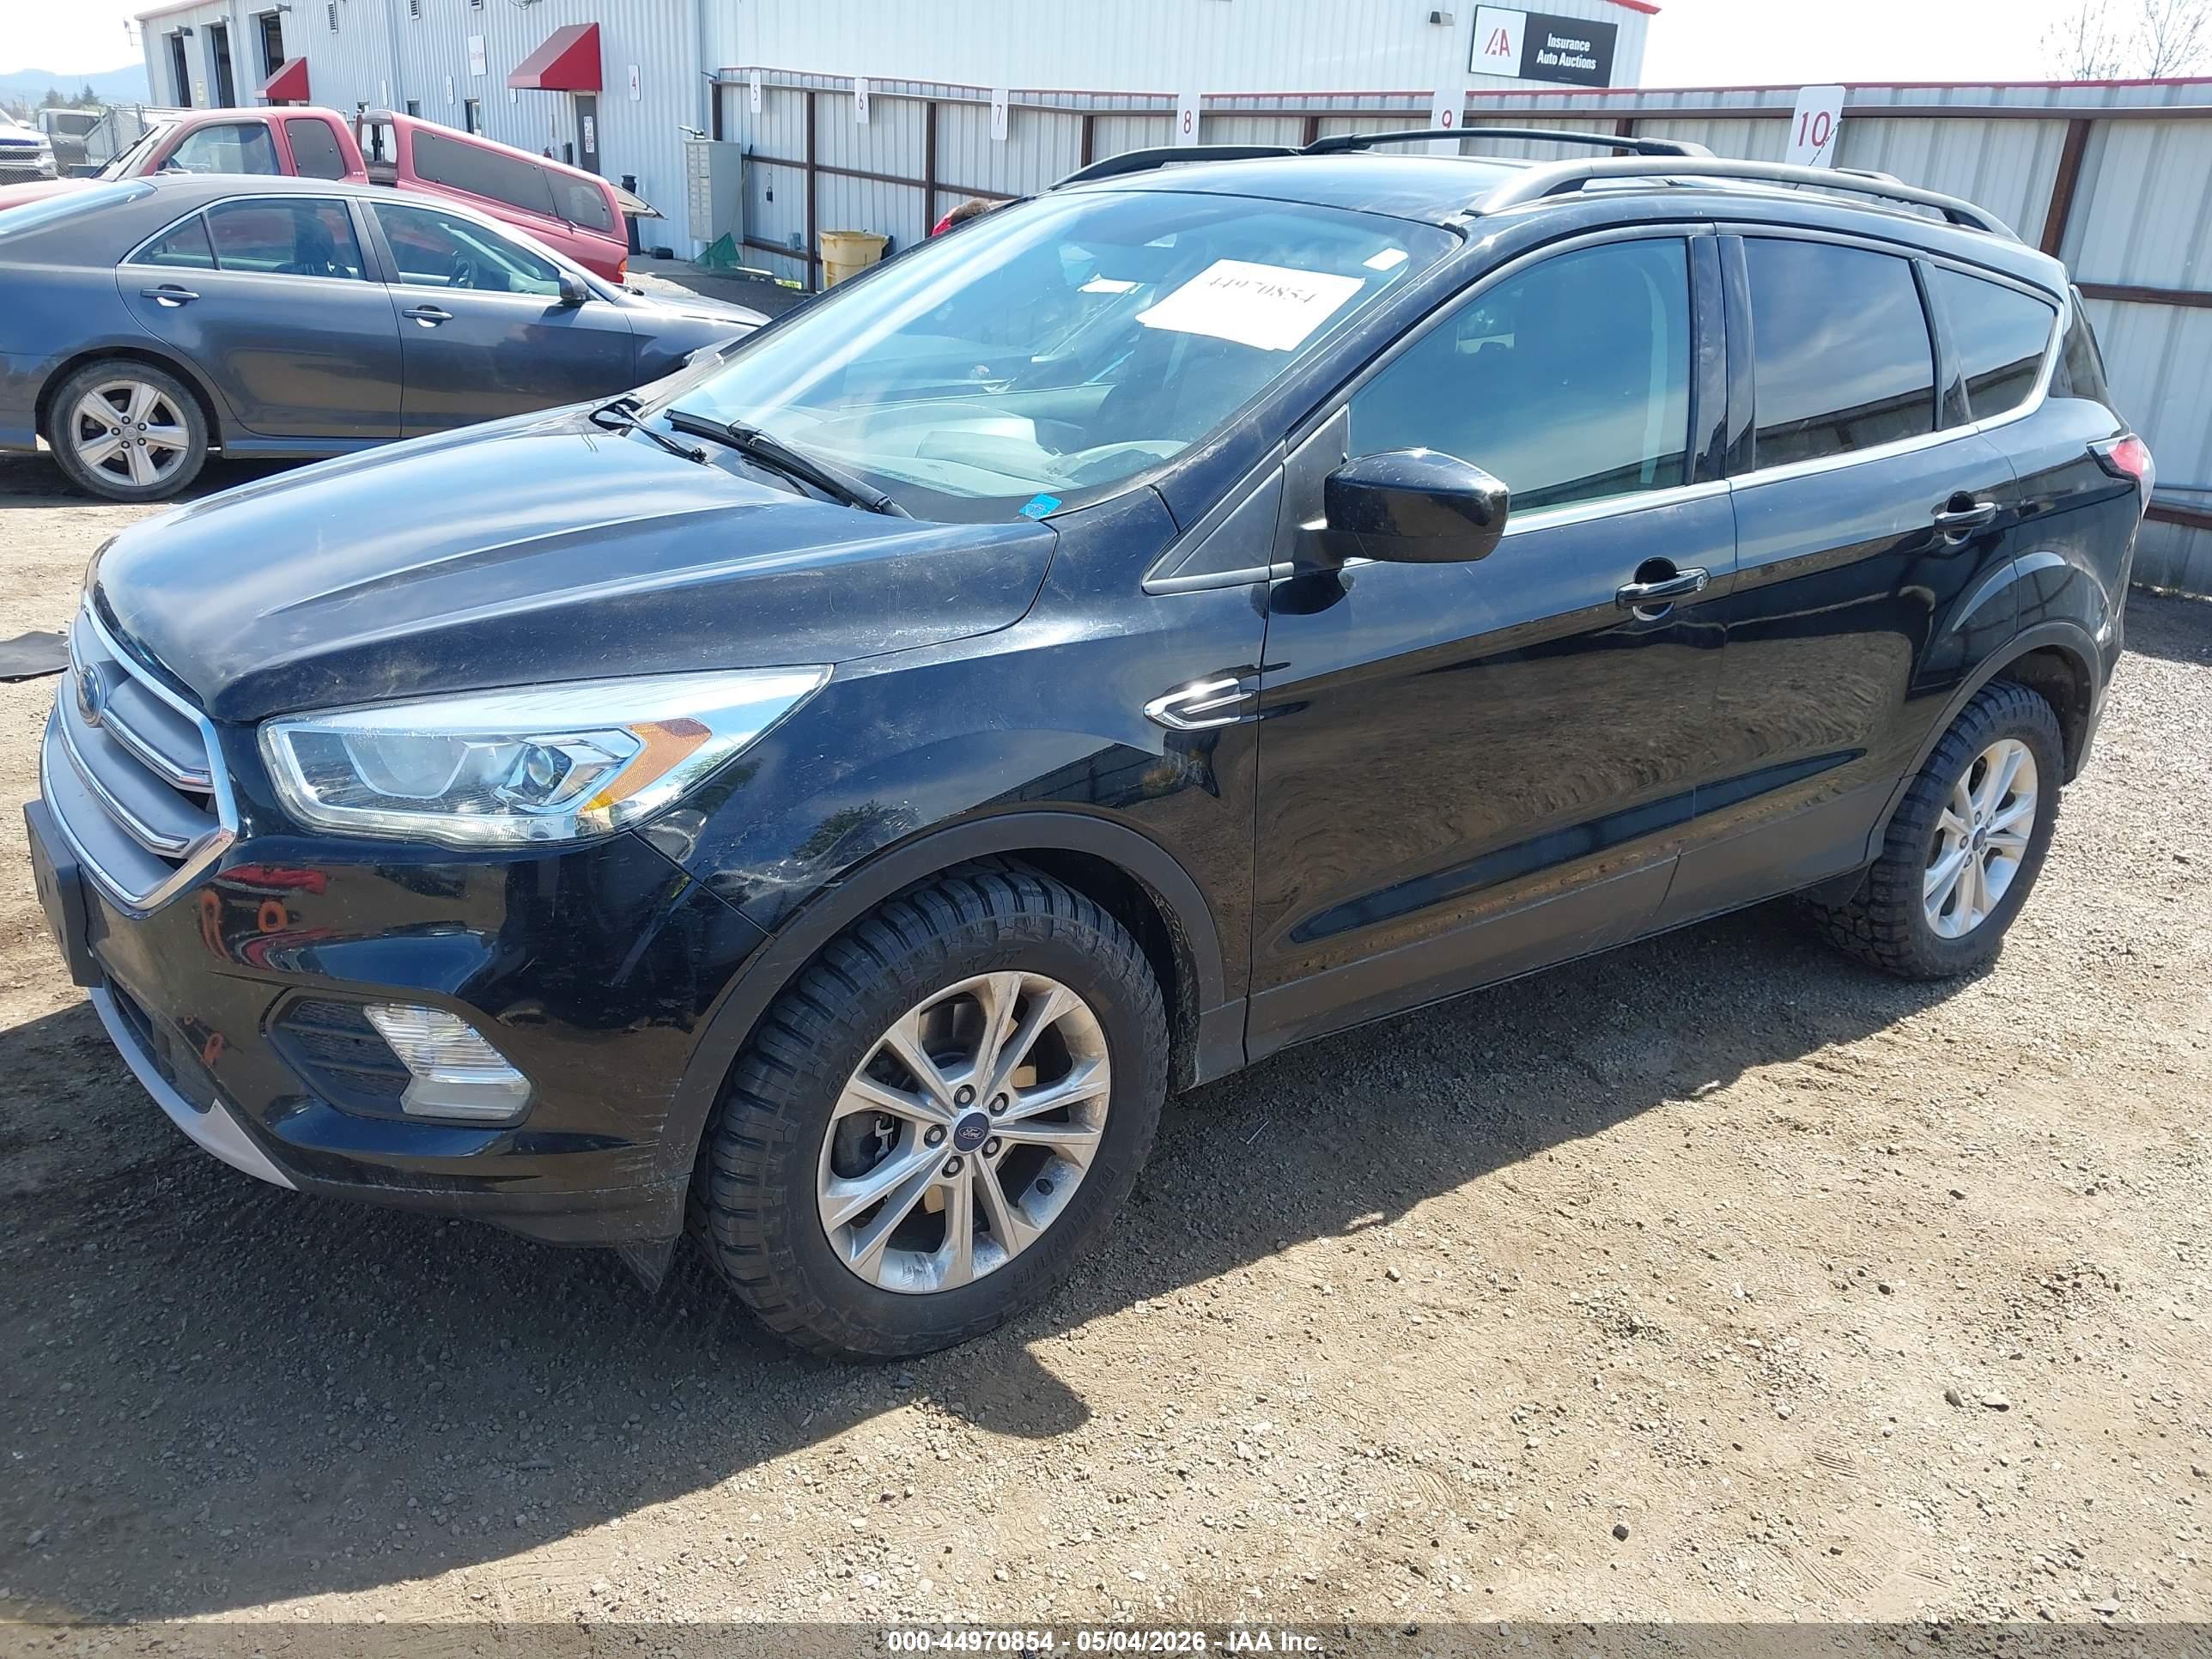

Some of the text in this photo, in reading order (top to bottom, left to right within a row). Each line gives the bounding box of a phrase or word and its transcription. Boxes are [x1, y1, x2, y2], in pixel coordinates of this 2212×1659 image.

[1547, 33, 1590, 52] Insurance
[1536, 49, 1596, 70] Auto Auctions
[631, 75, 637, 90] 4
[753, 84, 758, 101] 5
[859, 92, 864, 110] 6
[996, 104, 1003, 125] 7
[1183, 110, 1192, 134] 8
[1442, 109, 1453, 129] 9
[1798, 112, 1831, 147] 10
[961, 1127, 981, 1138] Ford
